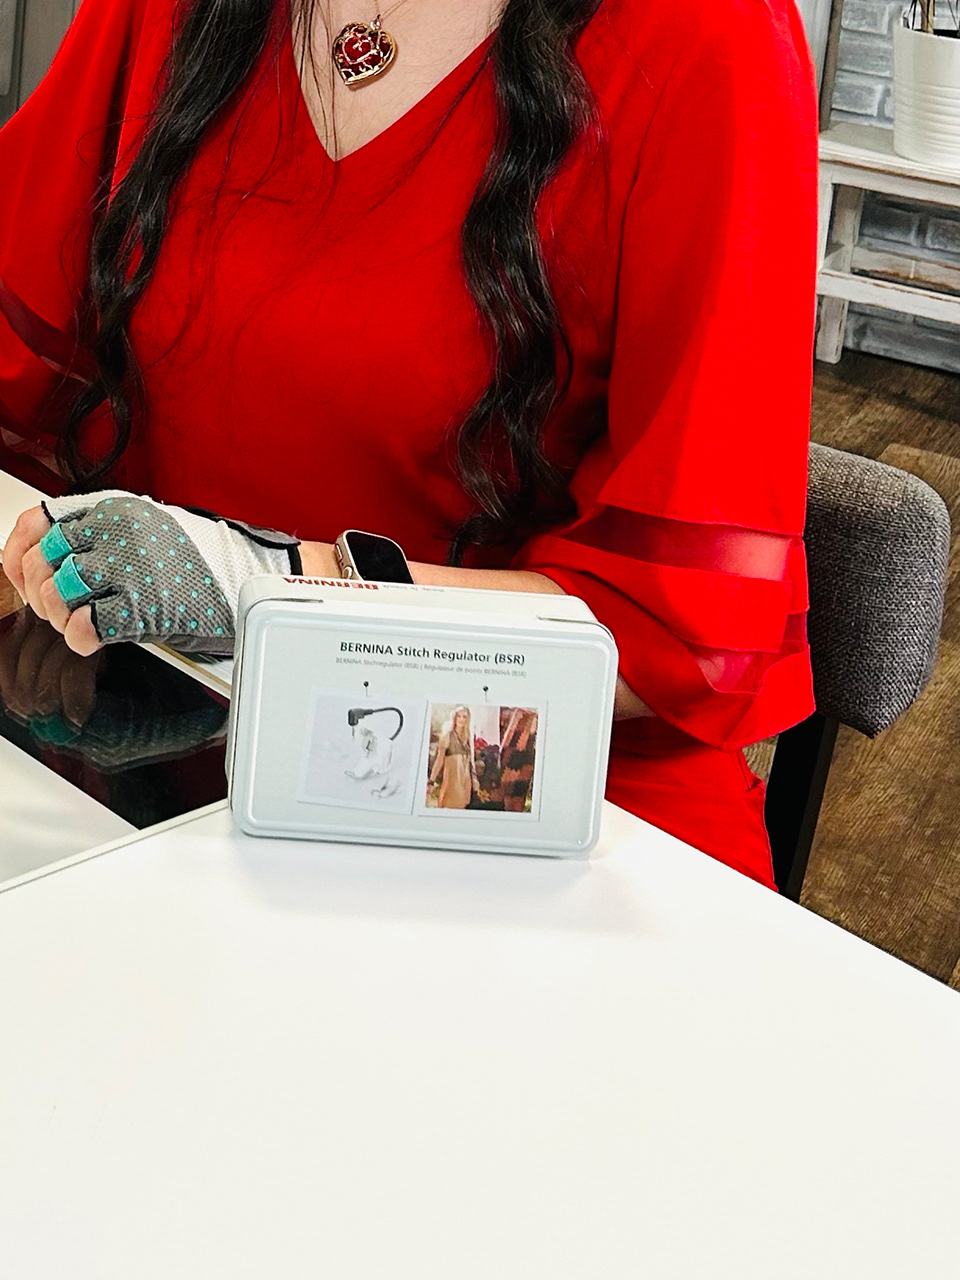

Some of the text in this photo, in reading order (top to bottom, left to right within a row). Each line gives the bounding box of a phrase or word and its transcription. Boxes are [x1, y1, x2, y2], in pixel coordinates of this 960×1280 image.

[283, 577, 380, 590] BERNINA
[340, 641, 525, 667] BERNINA Stitch Regulator (BSR)
